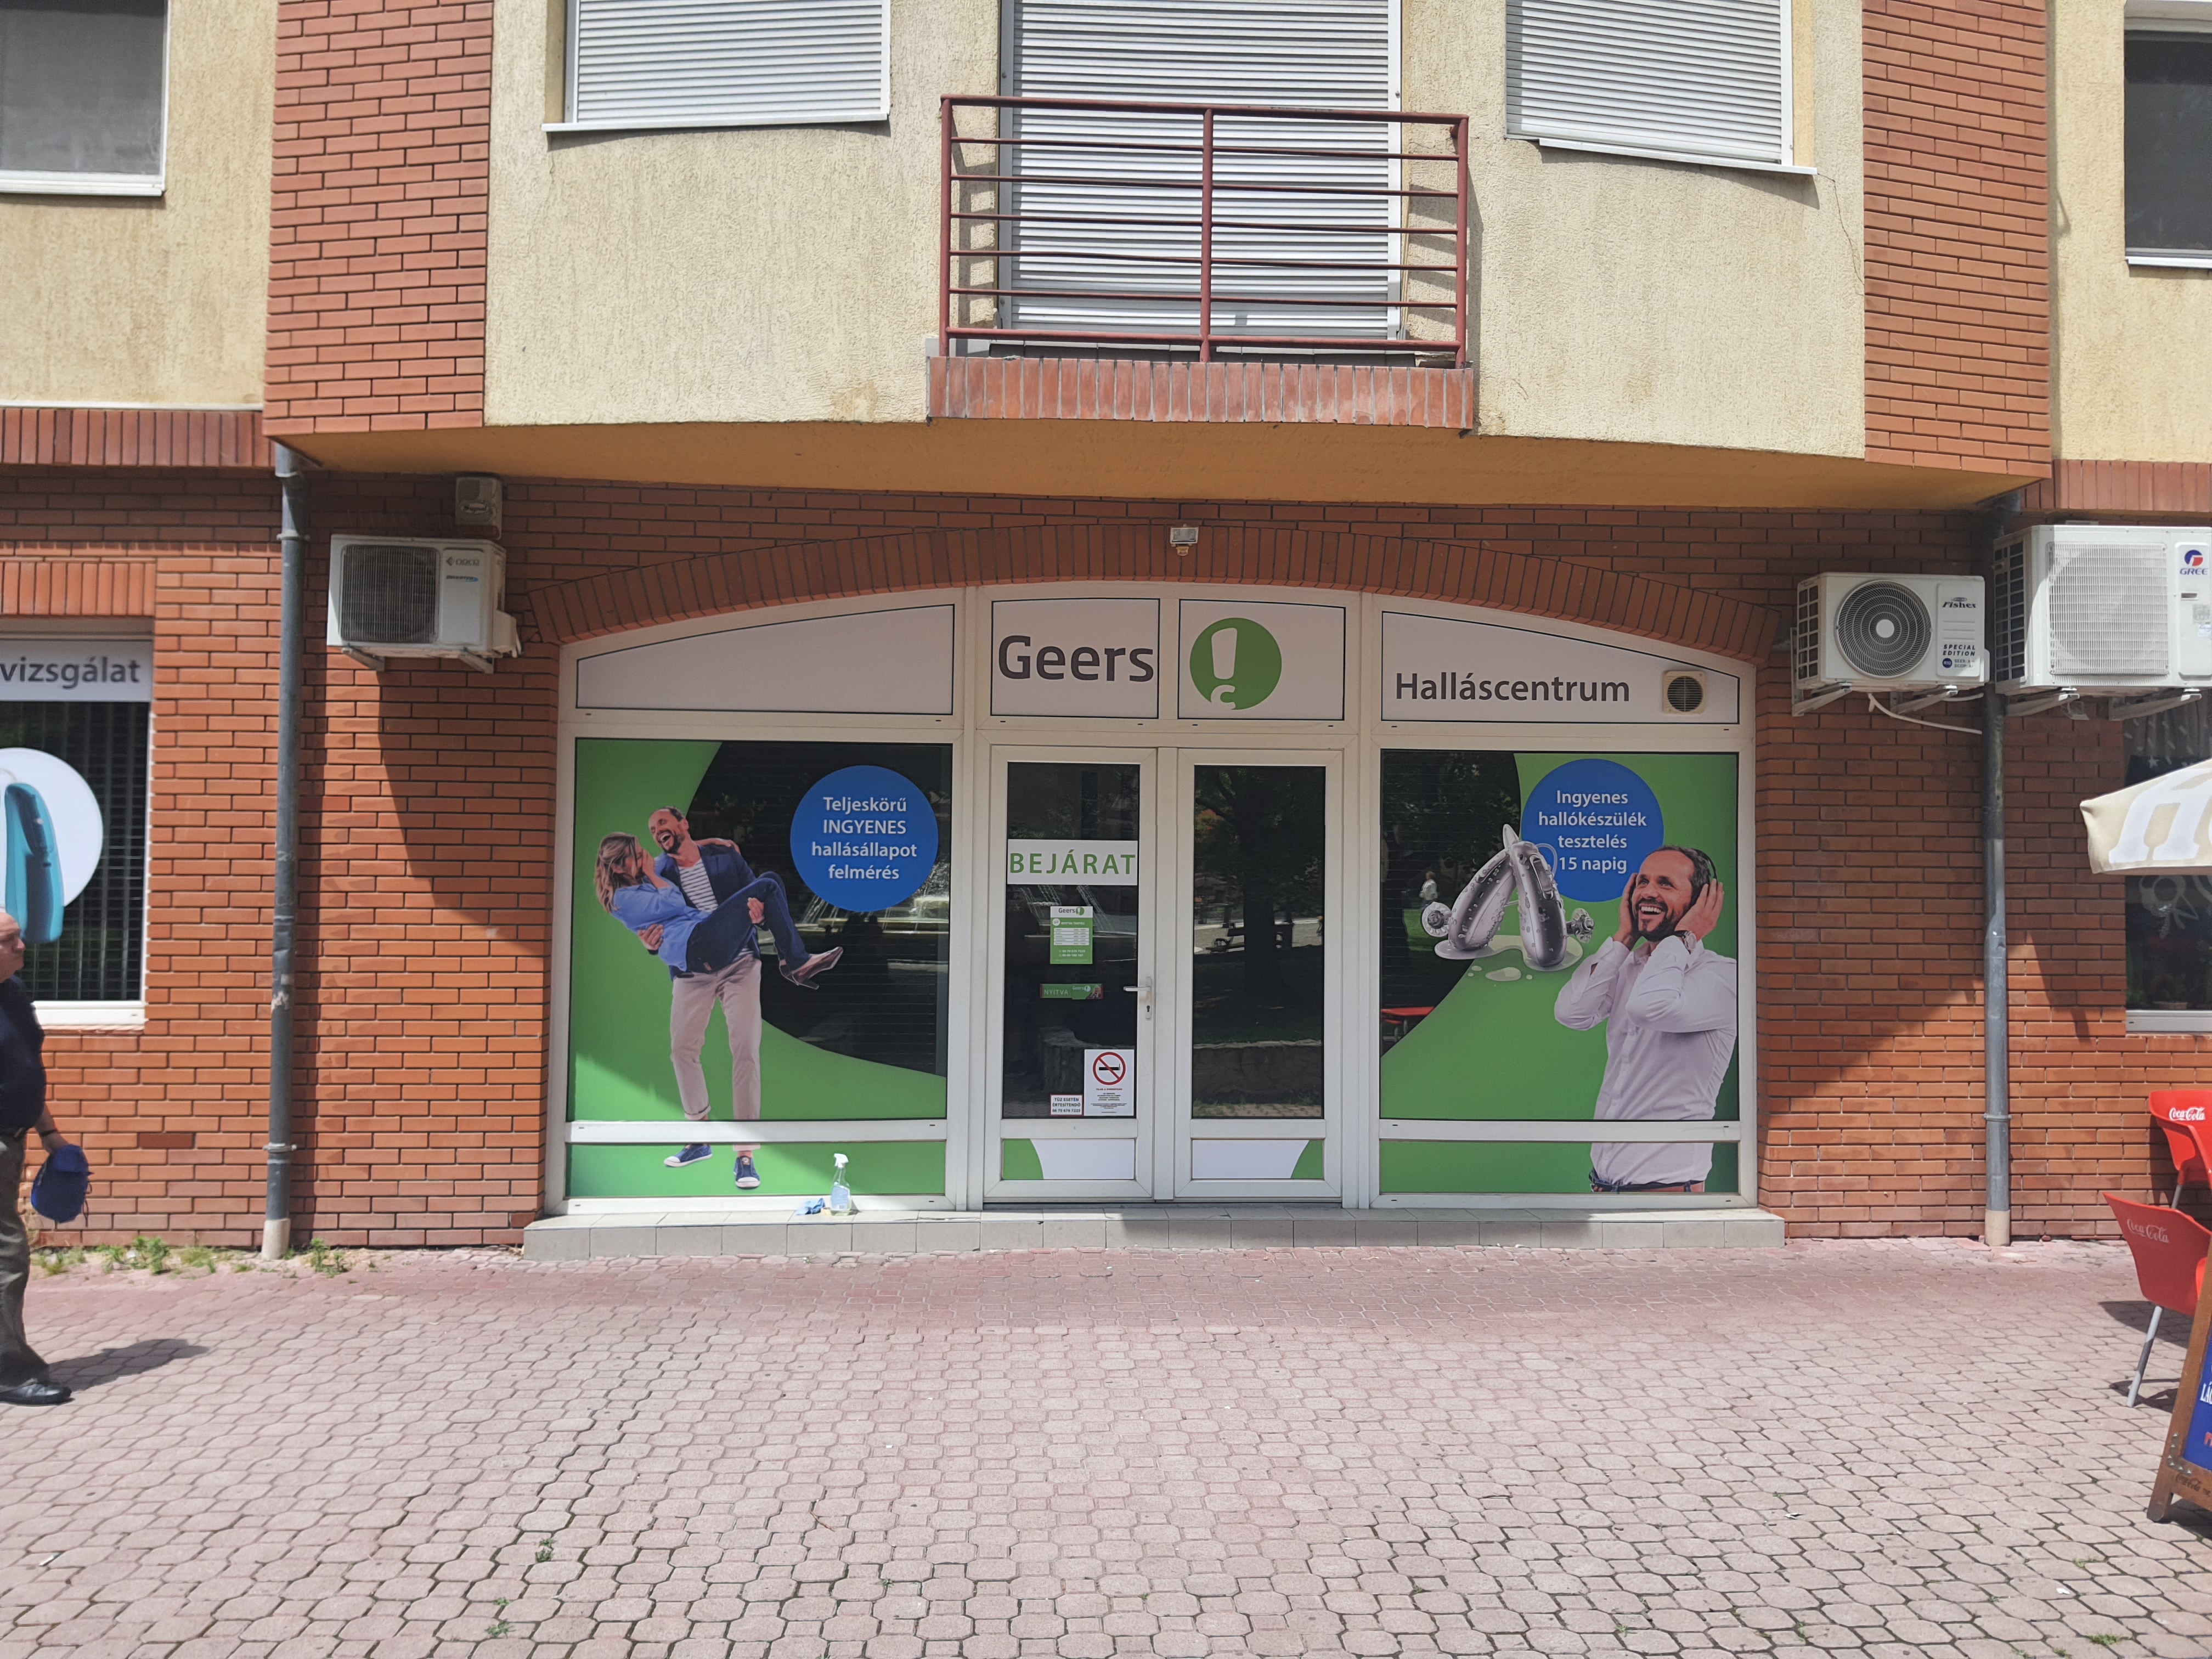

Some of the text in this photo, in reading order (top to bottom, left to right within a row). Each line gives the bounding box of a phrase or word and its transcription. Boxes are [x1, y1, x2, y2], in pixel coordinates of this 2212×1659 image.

[998, 635, 1154, 682] Geers
[0, 656, 141, 690] vizsgálat
[1396, 672, 1629, 702] Halláscentrum
[823, 797, 906, 815] Teljeskörű
[1557, 790, 1628, 808] Ingyenes
[823, 819, 906, 834] INGYENES
[1539, 811, 1647, 826] hallókészülék
[1558, 834, 1627, 848] tesztelés
[812, 841, 917, 860] hallásállapot
[1010, 849, 1136, 874] BEJÁRAT
[1559, 856, 1627, 874] 15 napig
[828, 864, 900, 879] felmérés
[2169, 1107, 2205, 1121] Coca-Cola
[2127, 1219, 2170, 1244] Coca-Cola
